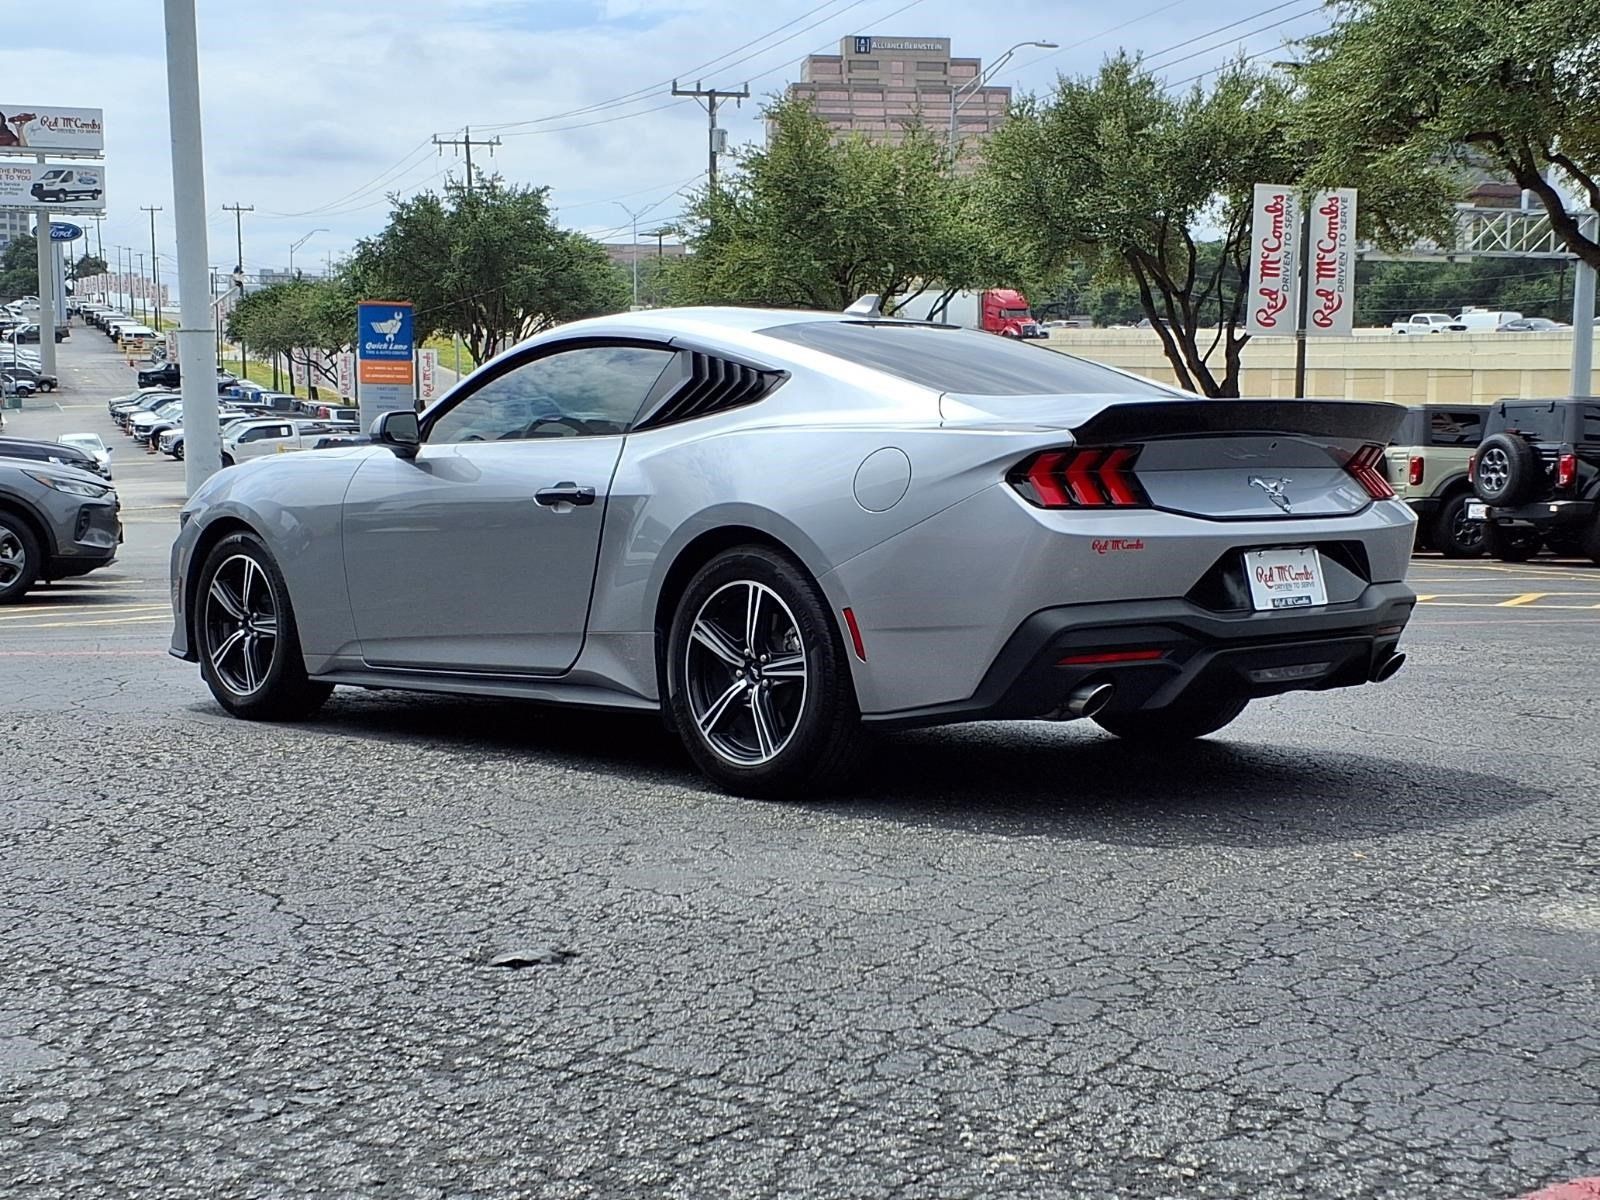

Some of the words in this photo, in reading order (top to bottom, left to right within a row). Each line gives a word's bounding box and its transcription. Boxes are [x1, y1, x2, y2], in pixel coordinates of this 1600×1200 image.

[40, 116, 58, 131] Red
[1284, 194, 1293, 229] SERVE
[1260, 195, 1285, 284] McCombs
[1284, 232, 1292, 246] TO
[1315, 196, 1339, 284] McCombs
[1339, 233, 1347, 248] TO
[1282, 251, 1291, 292] DRIVEN
[1337, 252, 1346, 292] DRIVEN
[1256, 288, 1287, 327] Red
[1312, 288, 1342, 327] Red
[365, 342, 388, 350] Quick
[1092, 539, 1109, 554] Red
[1110, 538, 1144, 550] McCombs
[1256, 566, 1274, 589] Red
[1274, 565, 1314, 582] McCombs
